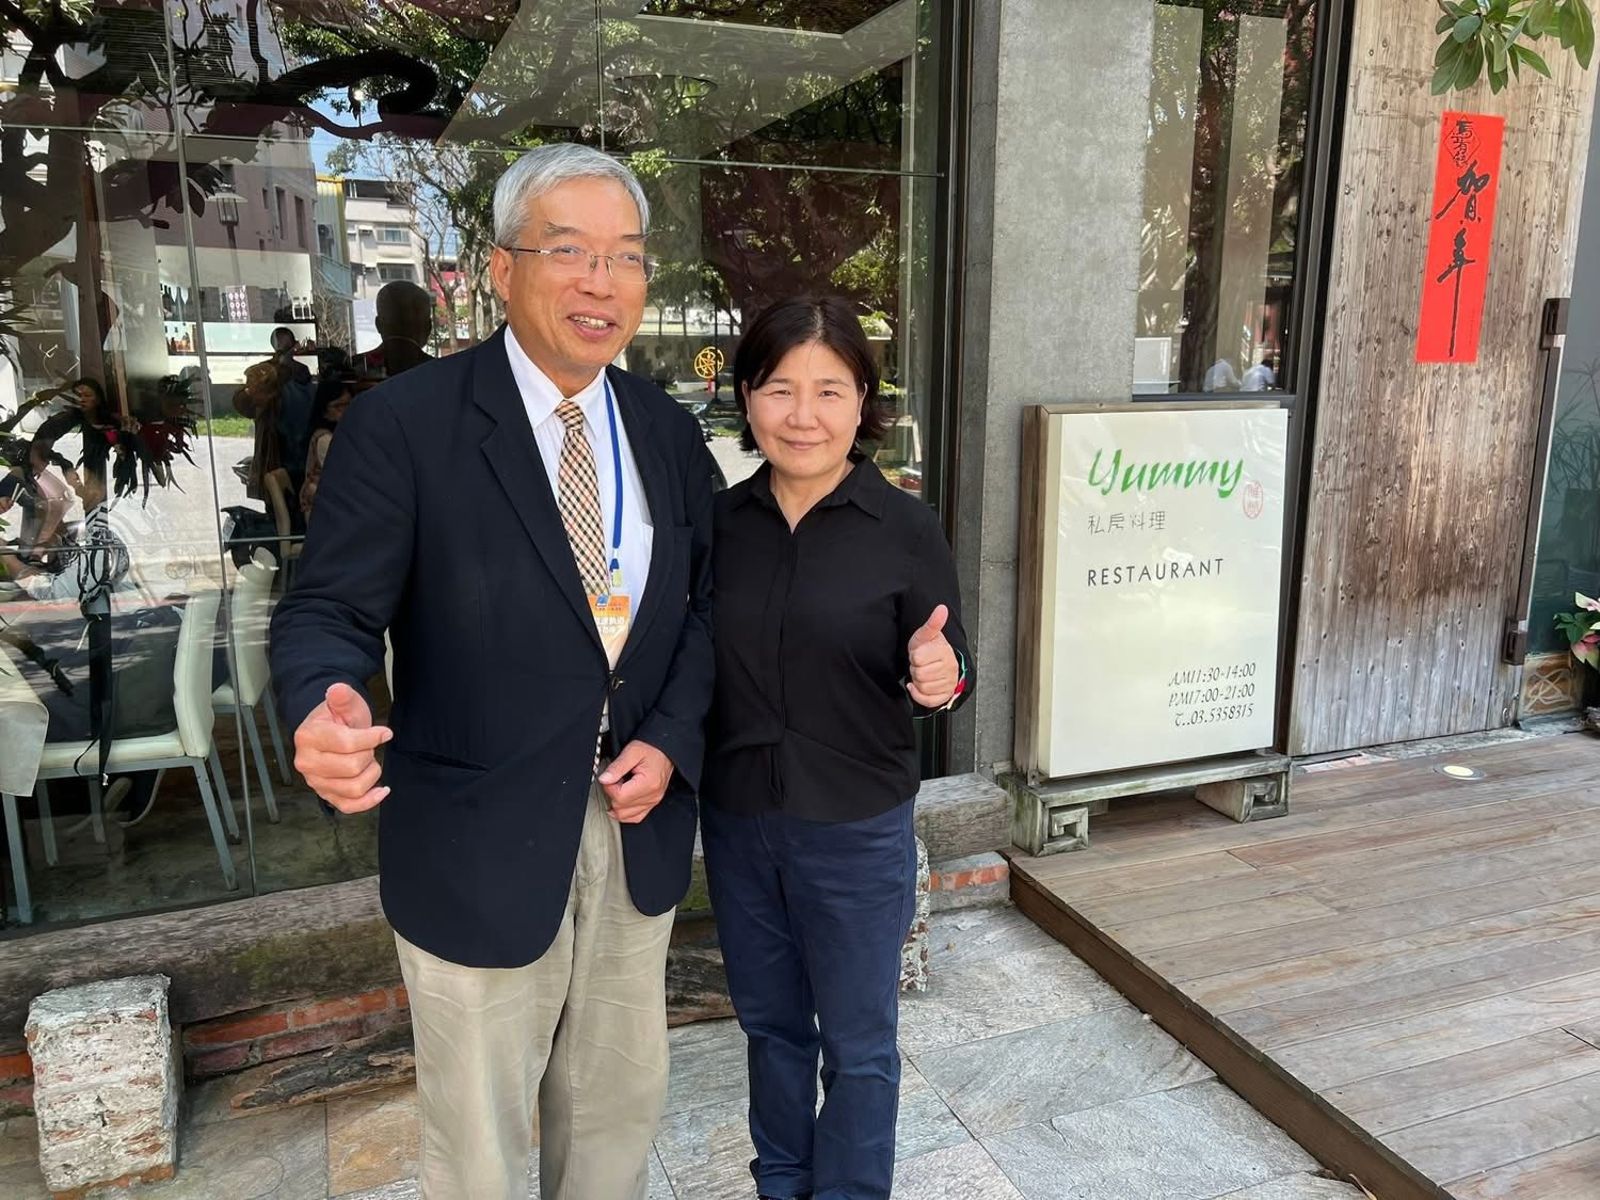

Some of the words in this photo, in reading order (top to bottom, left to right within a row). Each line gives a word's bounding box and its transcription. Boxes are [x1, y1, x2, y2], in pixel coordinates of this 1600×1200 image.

[1088, 448, 1244, 498] Yummy
[1087, 511, 1166, 535] 私房料理
[1087, 558, 1224, 587] RESTAURANT
